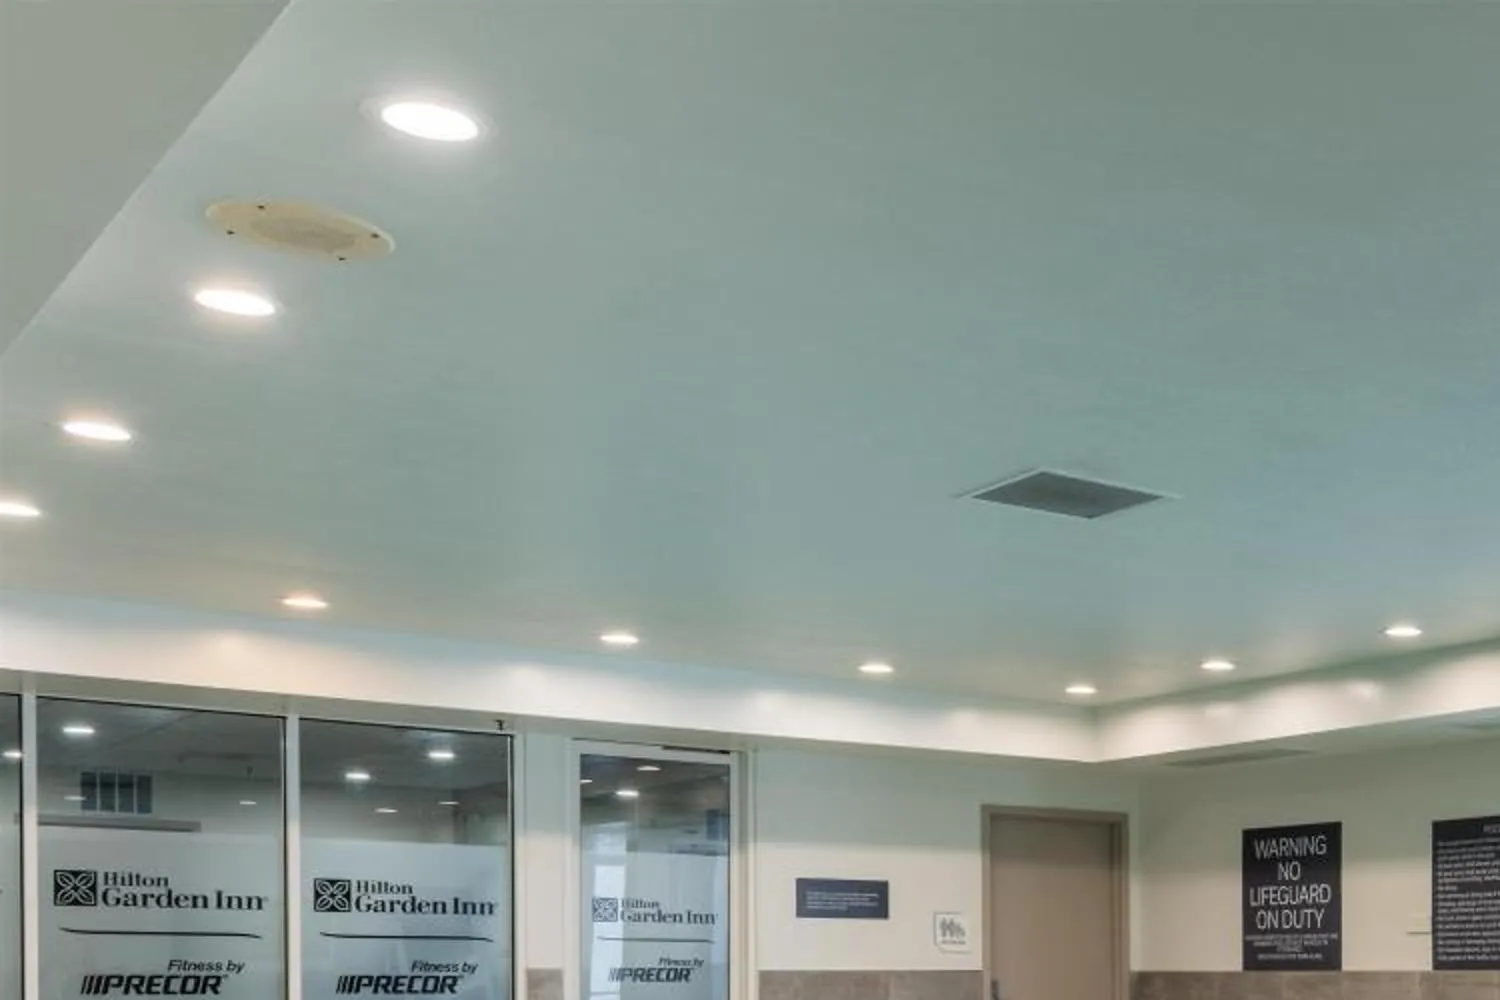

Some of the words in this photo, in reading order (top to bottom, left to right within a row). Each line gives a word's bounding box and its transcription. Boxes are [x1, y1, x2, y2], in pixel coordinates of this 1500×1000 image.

[1253, 835, 1328, 860] WARNING
[102, 871, 169, 888] Hilton
[1277, 861, 1301, 881] NO
[355, 879, 414, 895] Hilton
[1249, 883, 1332, 907] LIFEGUARD
[101, 888, 209, 910] Garden
[214, 890, 264, 911] Inn
[354, 895, 447, 914] Garden
[453, 897, 495, 916] Inn
[620, 909, 684, 924] Garden
[687, 909, 716, 925] Inn
[1255, 909, 1279, 930] ON
[1281, 907, 1325, 930] DUTY
[167, 959, 224, 973] Fitness
[226, 960, 246, 975] by
[411, 959, 459, 974] Fitness
[461, 961, 479, 975] by
[619, 967, 692, 983] PRECOR
[101, 974, 222, 996] PRECOR
[354, 974, 459, 995] PRECOR
